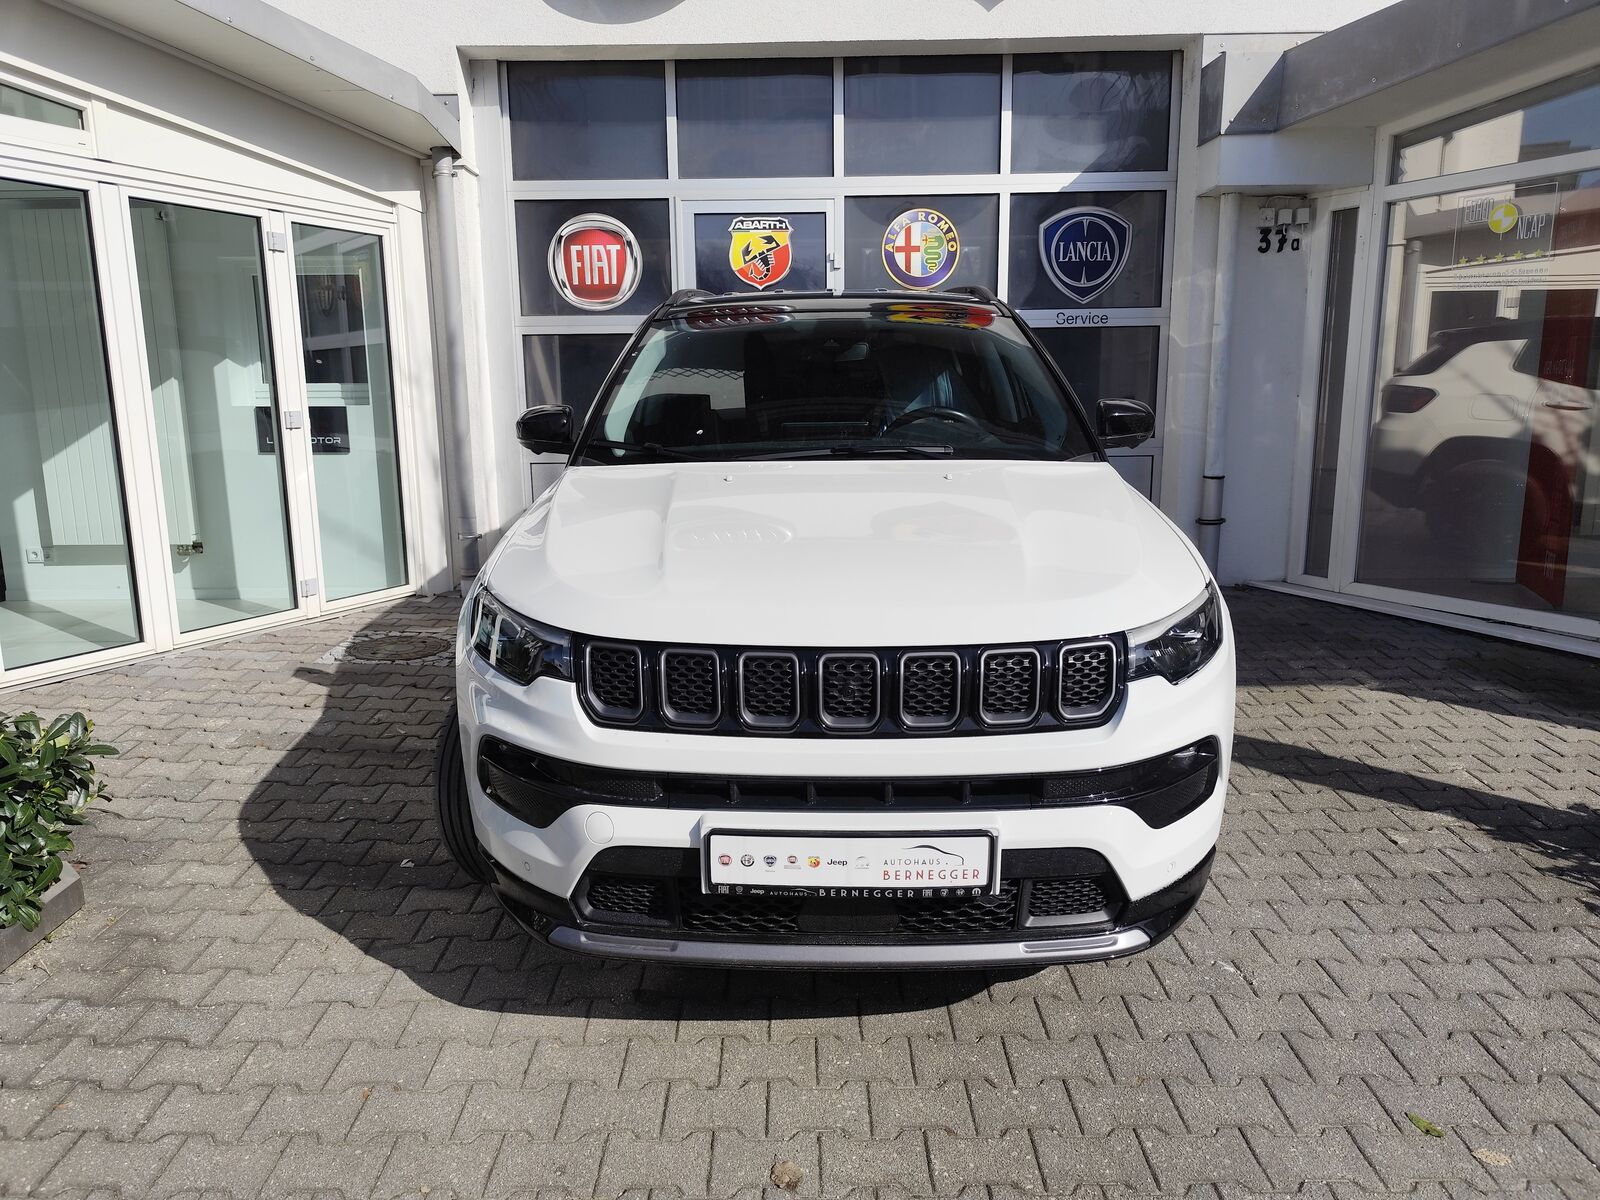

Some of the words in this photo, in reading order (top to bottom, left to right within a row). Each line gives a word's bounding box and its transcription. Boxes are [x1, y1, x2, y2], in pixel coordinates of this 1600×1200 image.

[734, 219, 786, 230] ABARTH
[1516, 214, 1546, 240] NCAP
[885, 217, 911, 253] ALFA
[918, 212, 958, 252] ROMEO
[1058, 241, 1112, 262] LANCIA
[570, 245, 621, 285] FIAT
[1056, 312, 1109, 325] Service
[827, 858, 848, 867] Jeep
[883, 869, 980, 881] BERNEGGER
[819, 888, 914, 898] BERNEGGER
